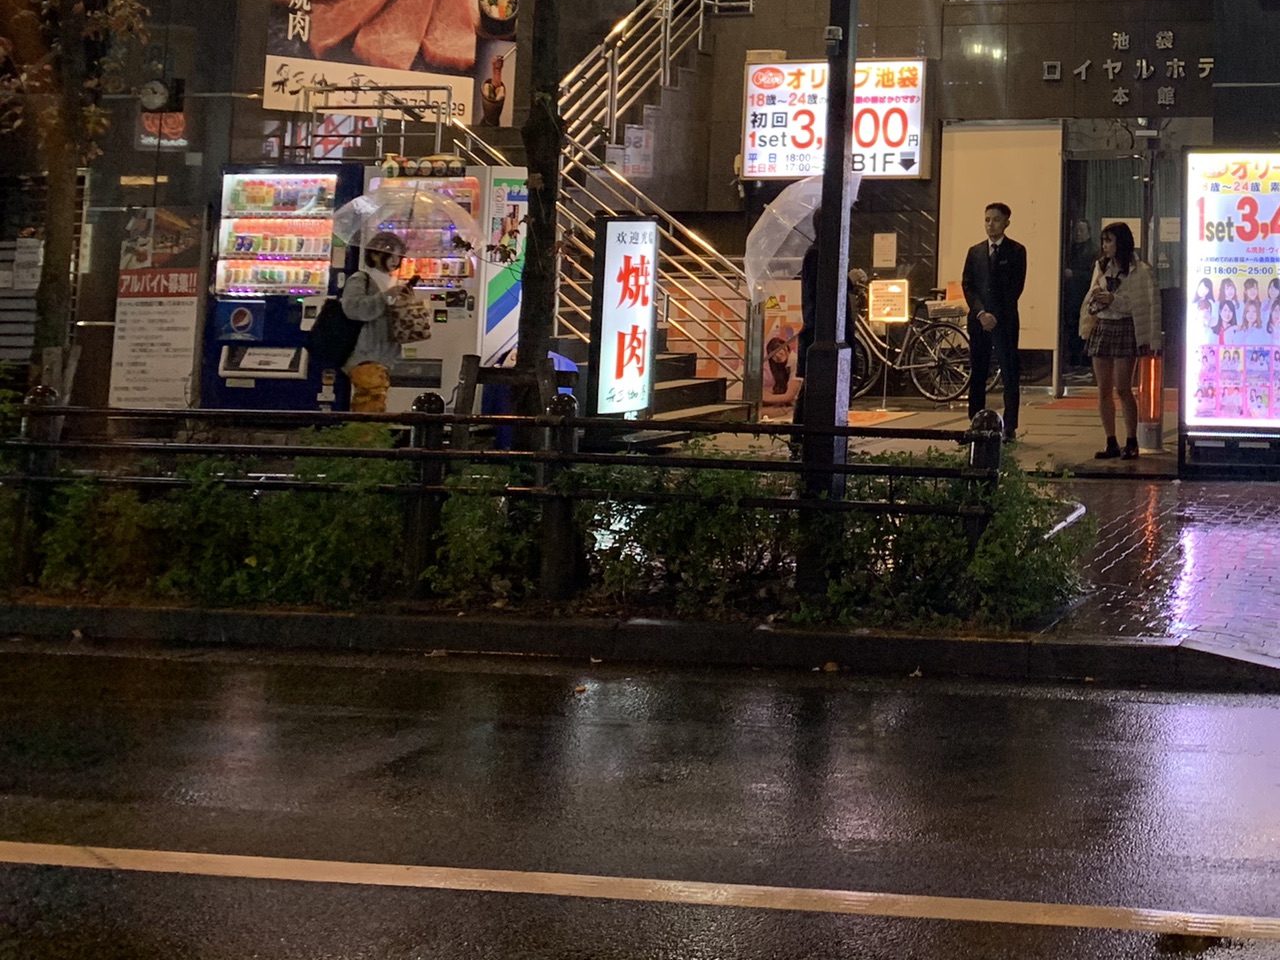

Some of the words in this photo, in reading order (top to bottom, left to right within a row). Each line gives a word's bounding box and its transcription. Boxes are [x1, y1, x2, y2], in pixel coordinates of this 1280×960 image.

[1112, 30, 1174, 50] 池袋
[787, 66, 918, 88] オリブ池袋
[1112, 87, 1175, 105] 本館
[751, 112, 787, 128] 初回
[791, 107, 919, 150] 3,00円
[749, 131, 787, 148] 1set
[852, 152, 896, 172] B1F
[120, 272, 197, 294] アルバイト募集!!
[616, 255, 650, 380] 焼肉
